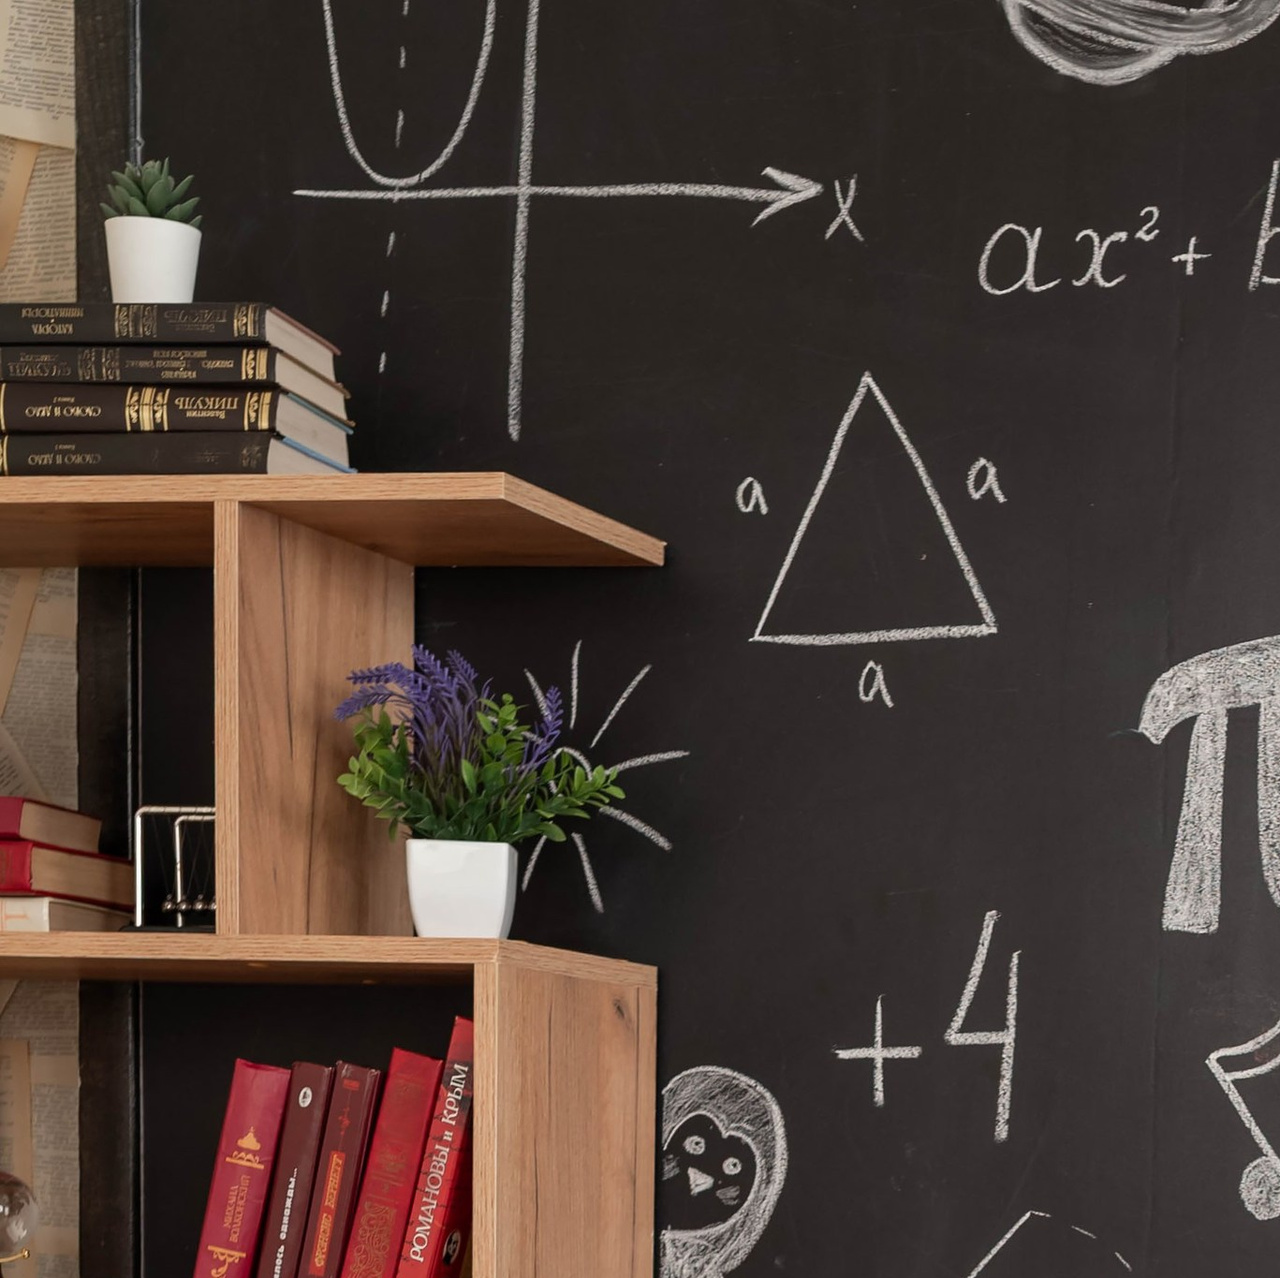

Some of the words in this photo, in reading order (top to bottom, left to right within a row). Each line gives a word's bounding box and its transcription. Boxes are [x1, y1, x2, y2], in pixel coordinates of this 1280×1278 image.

[174, 396, 239, 410] ПИКУЛЬ
[63, 405, 102, 417] СЛОВО
[186, 408, 226, 419] Валентин
[409, 1143, 452, 1264] РОМАНОВЫ
[441, 1063, 470, 1126] КРЫМ
[279, 1167, 299, 1241] однажды...
